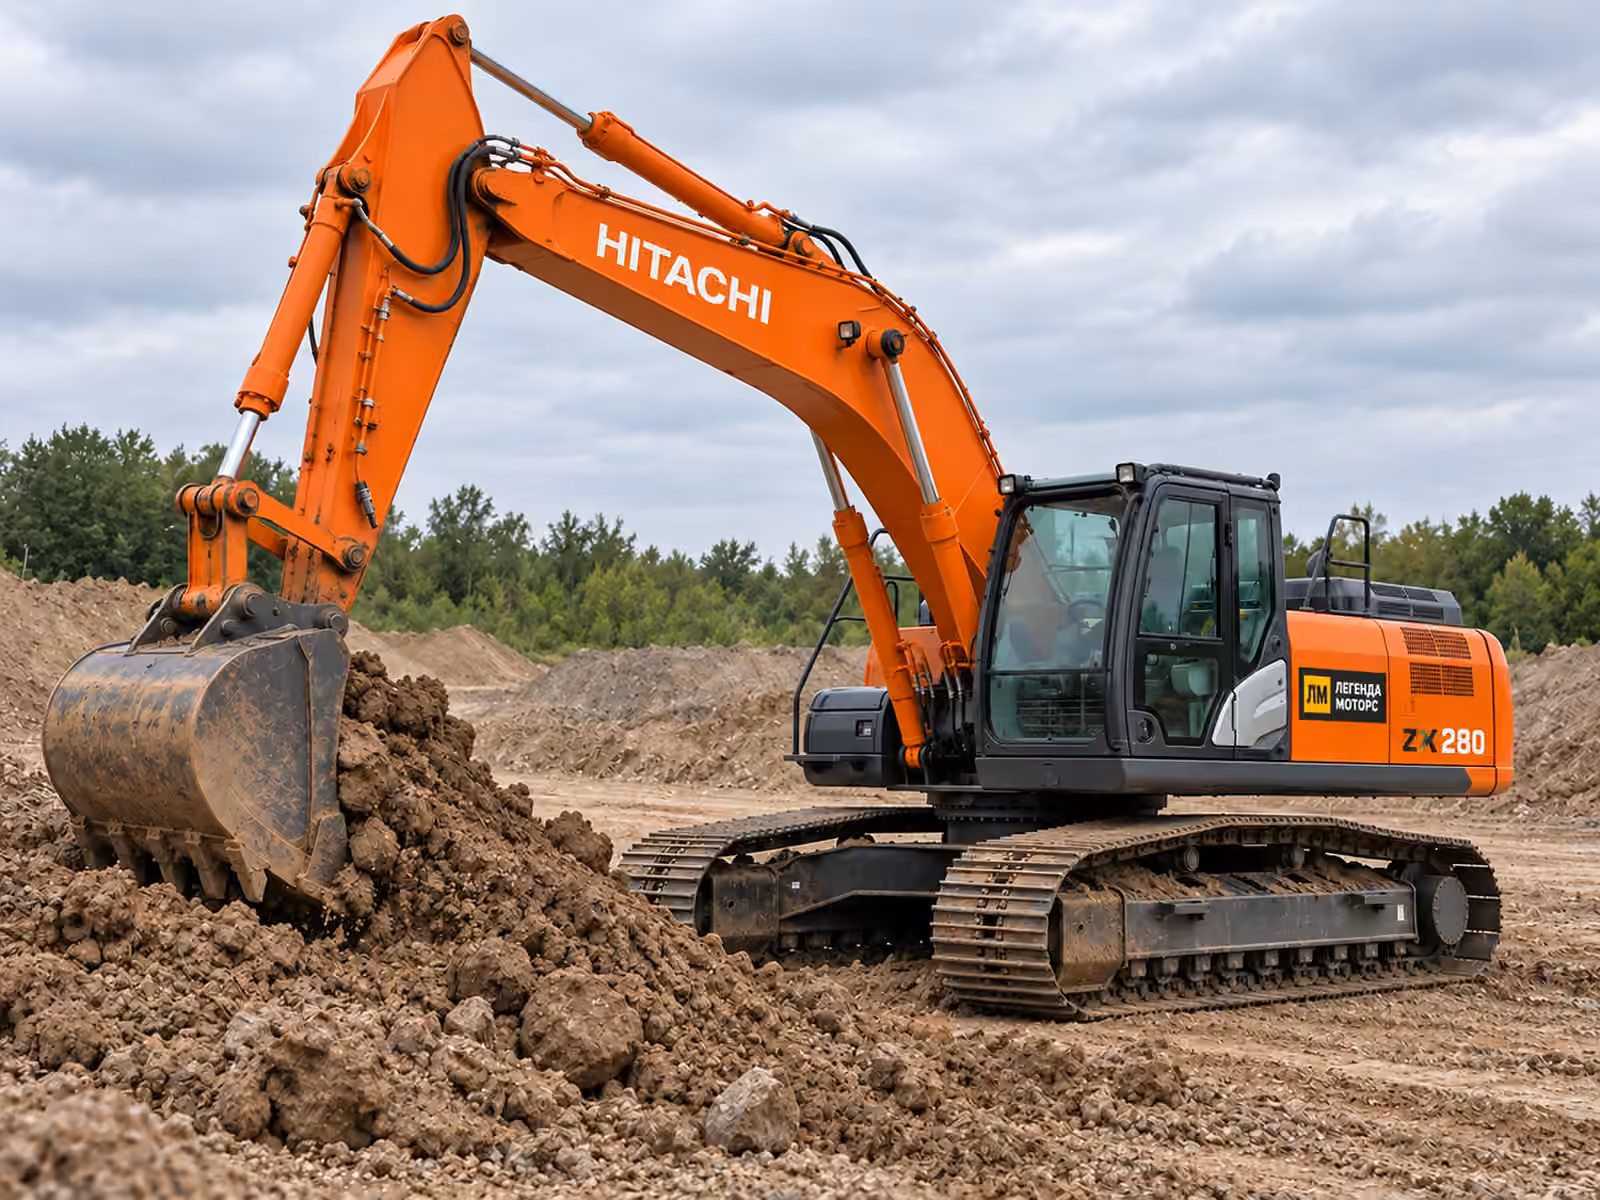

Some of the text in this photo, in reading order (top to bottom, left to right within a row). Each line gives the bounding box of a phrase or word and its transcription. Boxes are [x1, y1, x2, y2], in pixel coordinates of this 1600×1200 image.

[596, 222, 772, 325] HITACHI
[1306, 684, 1328, 704] ЛМ
[1335, 681, 1382, 698] ЛЕГЕНДА
[1335, 697, 1379, 712] МОТОРС
